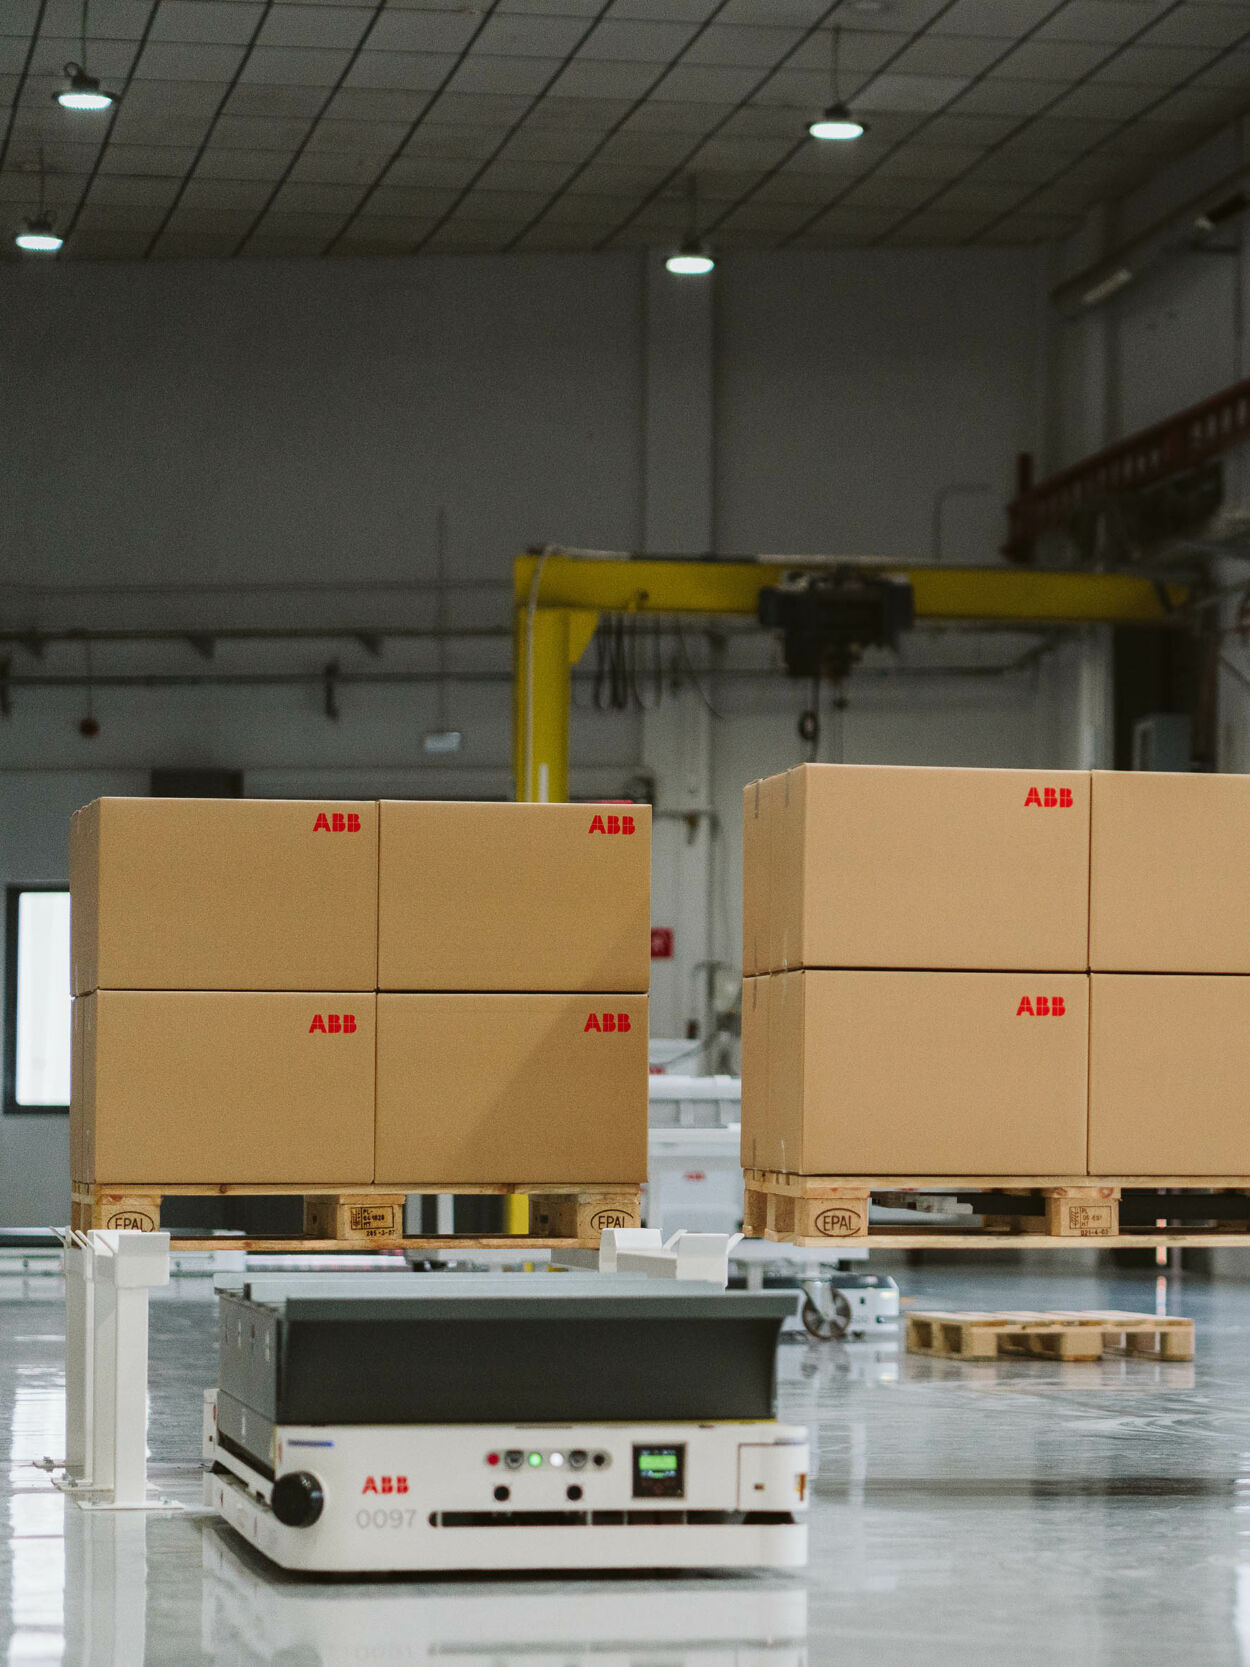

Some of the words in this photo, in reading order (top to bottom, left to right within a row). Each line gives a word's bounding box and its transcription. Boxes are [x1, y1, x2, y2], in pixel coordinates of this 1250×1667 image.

[1024, 787, 1074, 808] ABB
[312, 812, 361, 833] ABB
[588, 815, 636, 835] ABB
[1016, 996, 1066, 1017] ABB
[308, 1014, 357, 1034] ABB
[583, 1013, 631, 1033] ABB
[823, 1215, 856, 1231] EPAL
[362, 1475, 409, 1494] ABB
[356, 1508, 417, 1529] 0097
